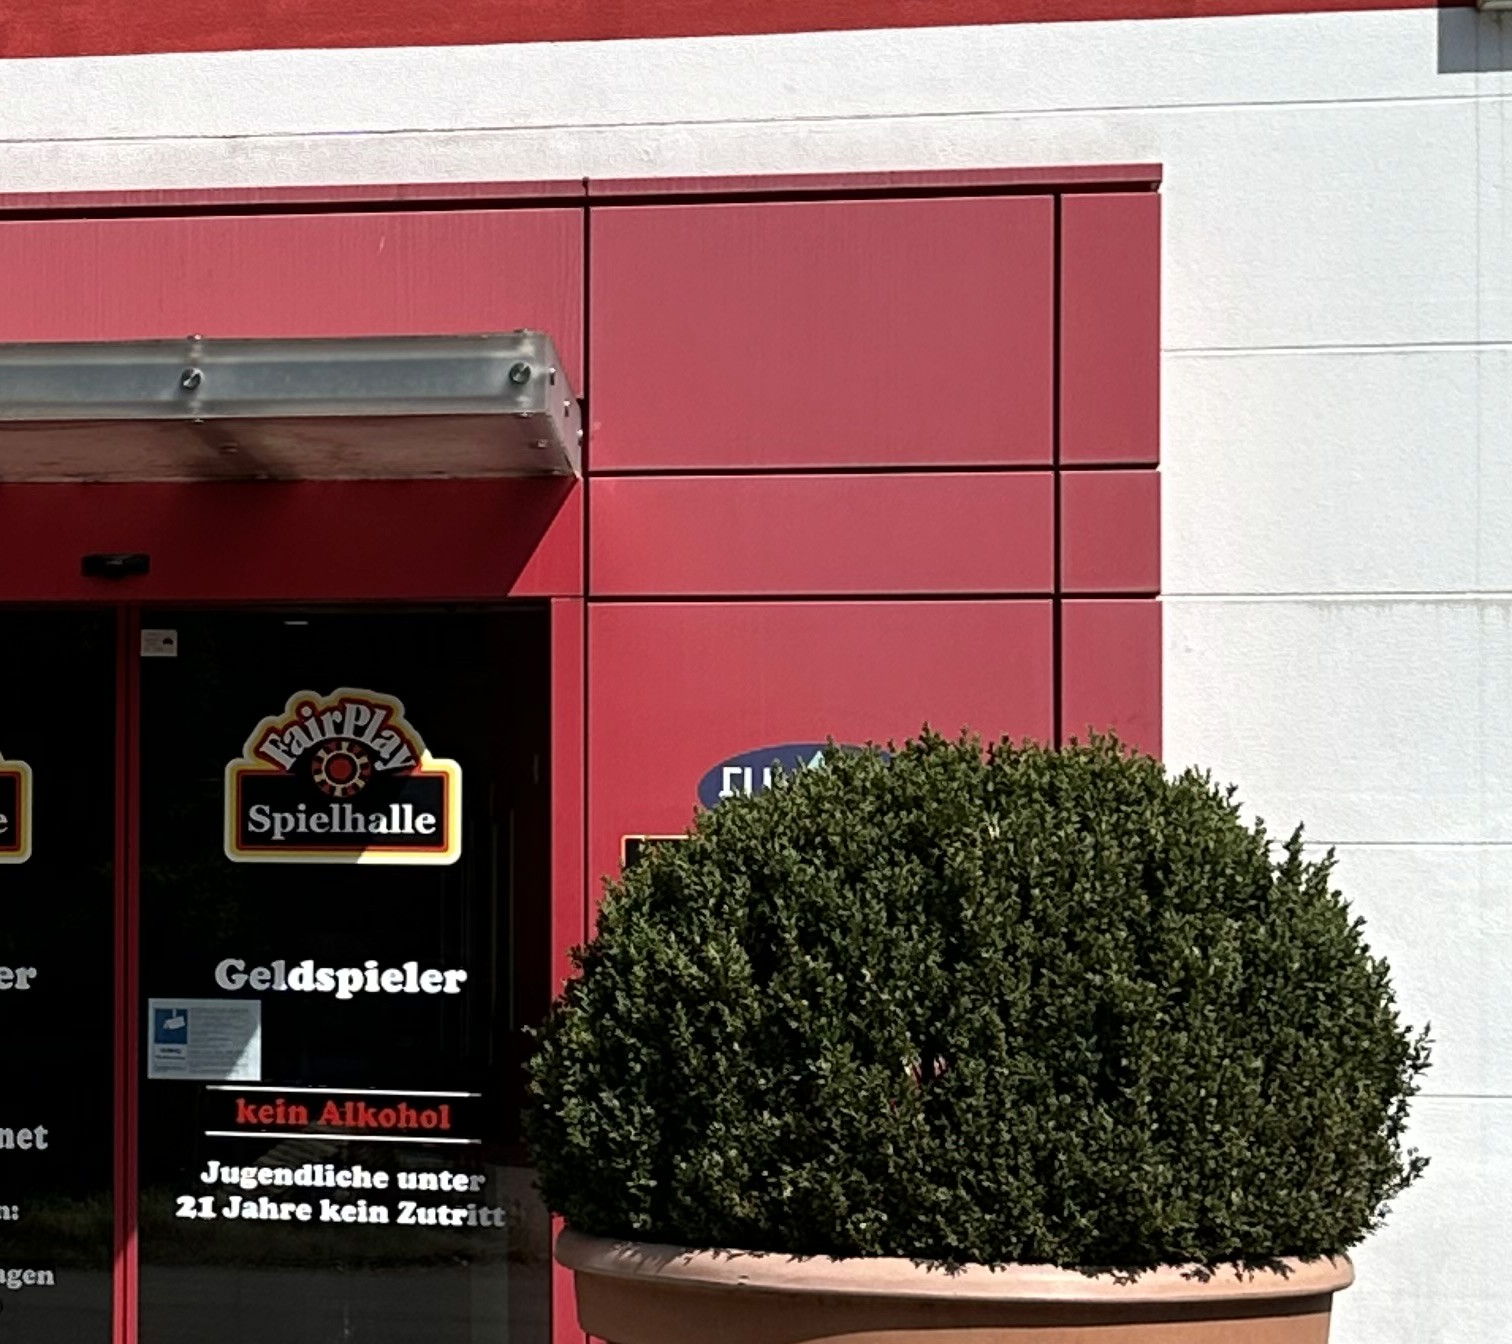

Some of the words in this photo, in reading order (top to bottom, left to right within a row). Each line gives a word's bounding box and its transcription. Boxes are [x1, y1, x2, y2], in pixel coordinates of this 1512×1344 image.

[259, 704, 417, 771] FairPlay
[248, 803, 436, 840] Spielhalle
[215, 958, 468, 999] Geldspieler
[236, 1098, 308, 1125] kein
[318, 1100, 451, 1130] Alkohol
[200, 1161, 389, 1189] Jugendliche
[397, 1171, 486, 1191] unter
[176, 1196, 217, 1219] 21
[222, 1196, 312, 1221] Jahre
[319, 1199, 389, 1223] kein
[397, 1201, 506, 1227] Zutritt
